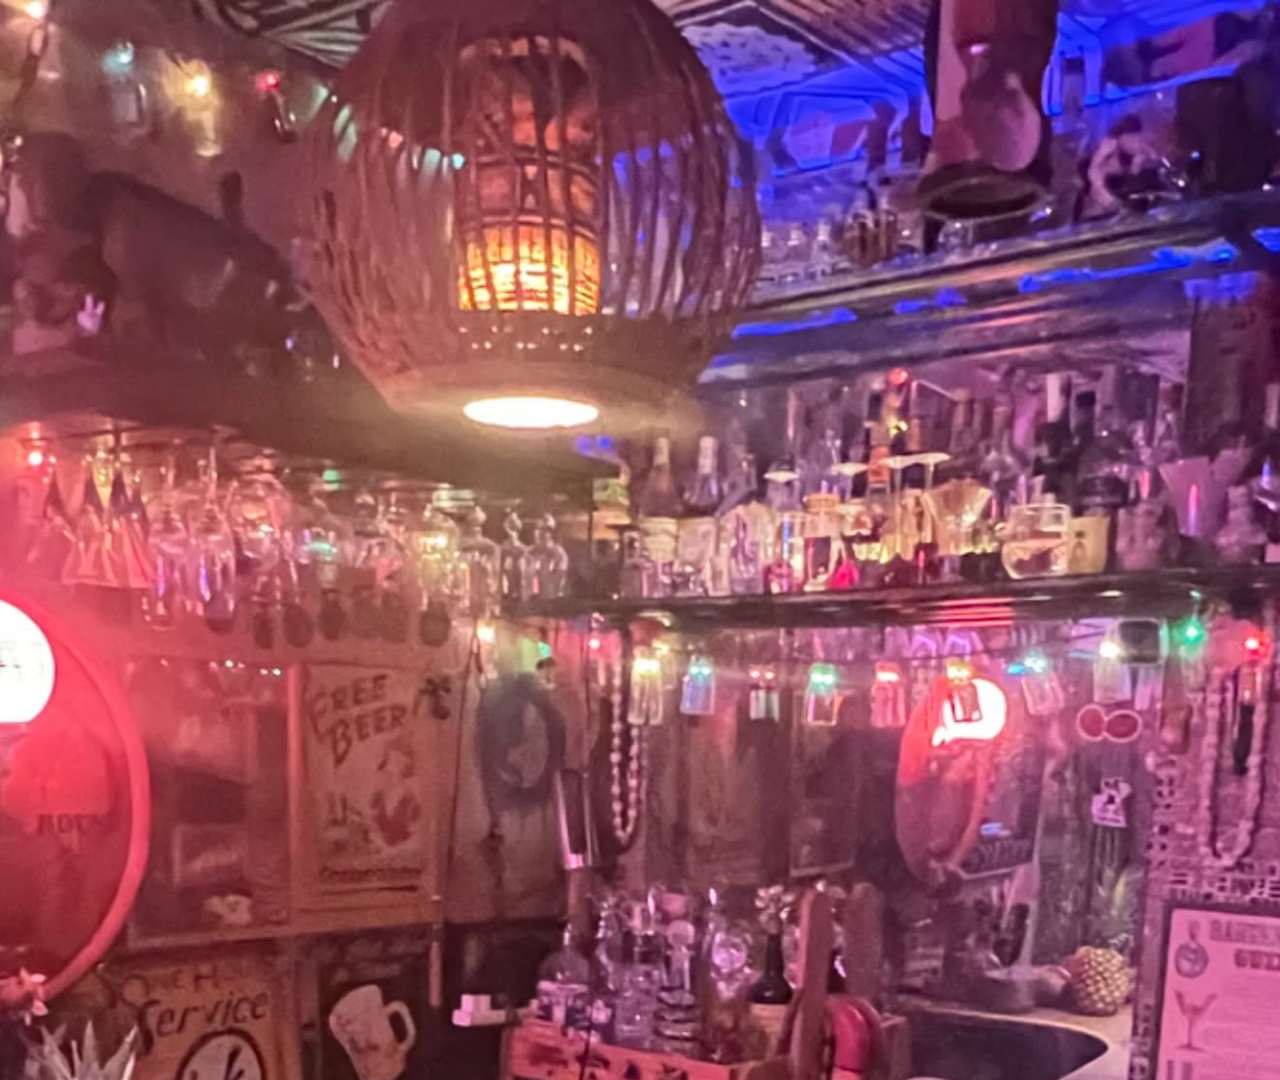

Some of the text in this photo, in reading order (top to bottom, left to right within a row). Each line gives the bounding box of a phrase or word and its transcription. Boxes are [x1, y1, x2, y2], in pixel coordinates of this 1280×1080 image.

[308, 673, 388, 742] FREE
[331, 704, 408, 768] BEER
[136, 989, 270, 1057] Service
